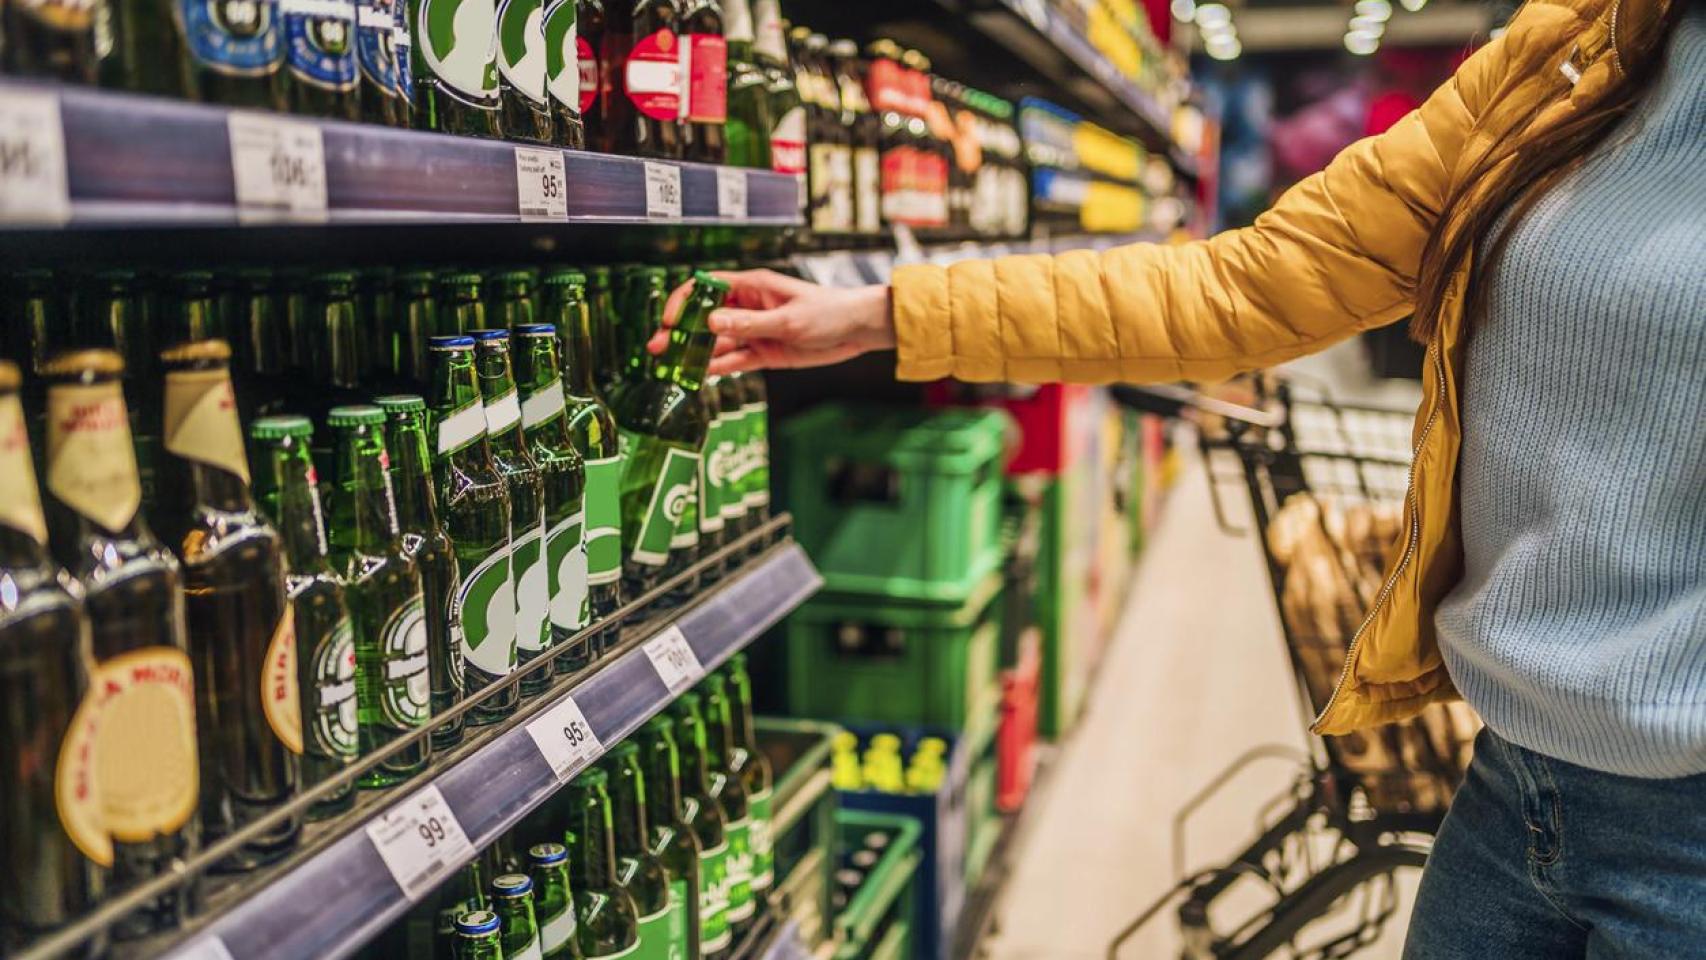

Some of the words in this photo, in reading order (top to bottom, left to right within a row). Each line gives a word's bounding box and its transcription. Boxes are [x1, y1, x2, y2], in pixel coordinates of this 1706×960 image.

[542, 174, 557, 198] 95
[564, 721, 584, 747] 95
[419, 817, 445, 847] 99
